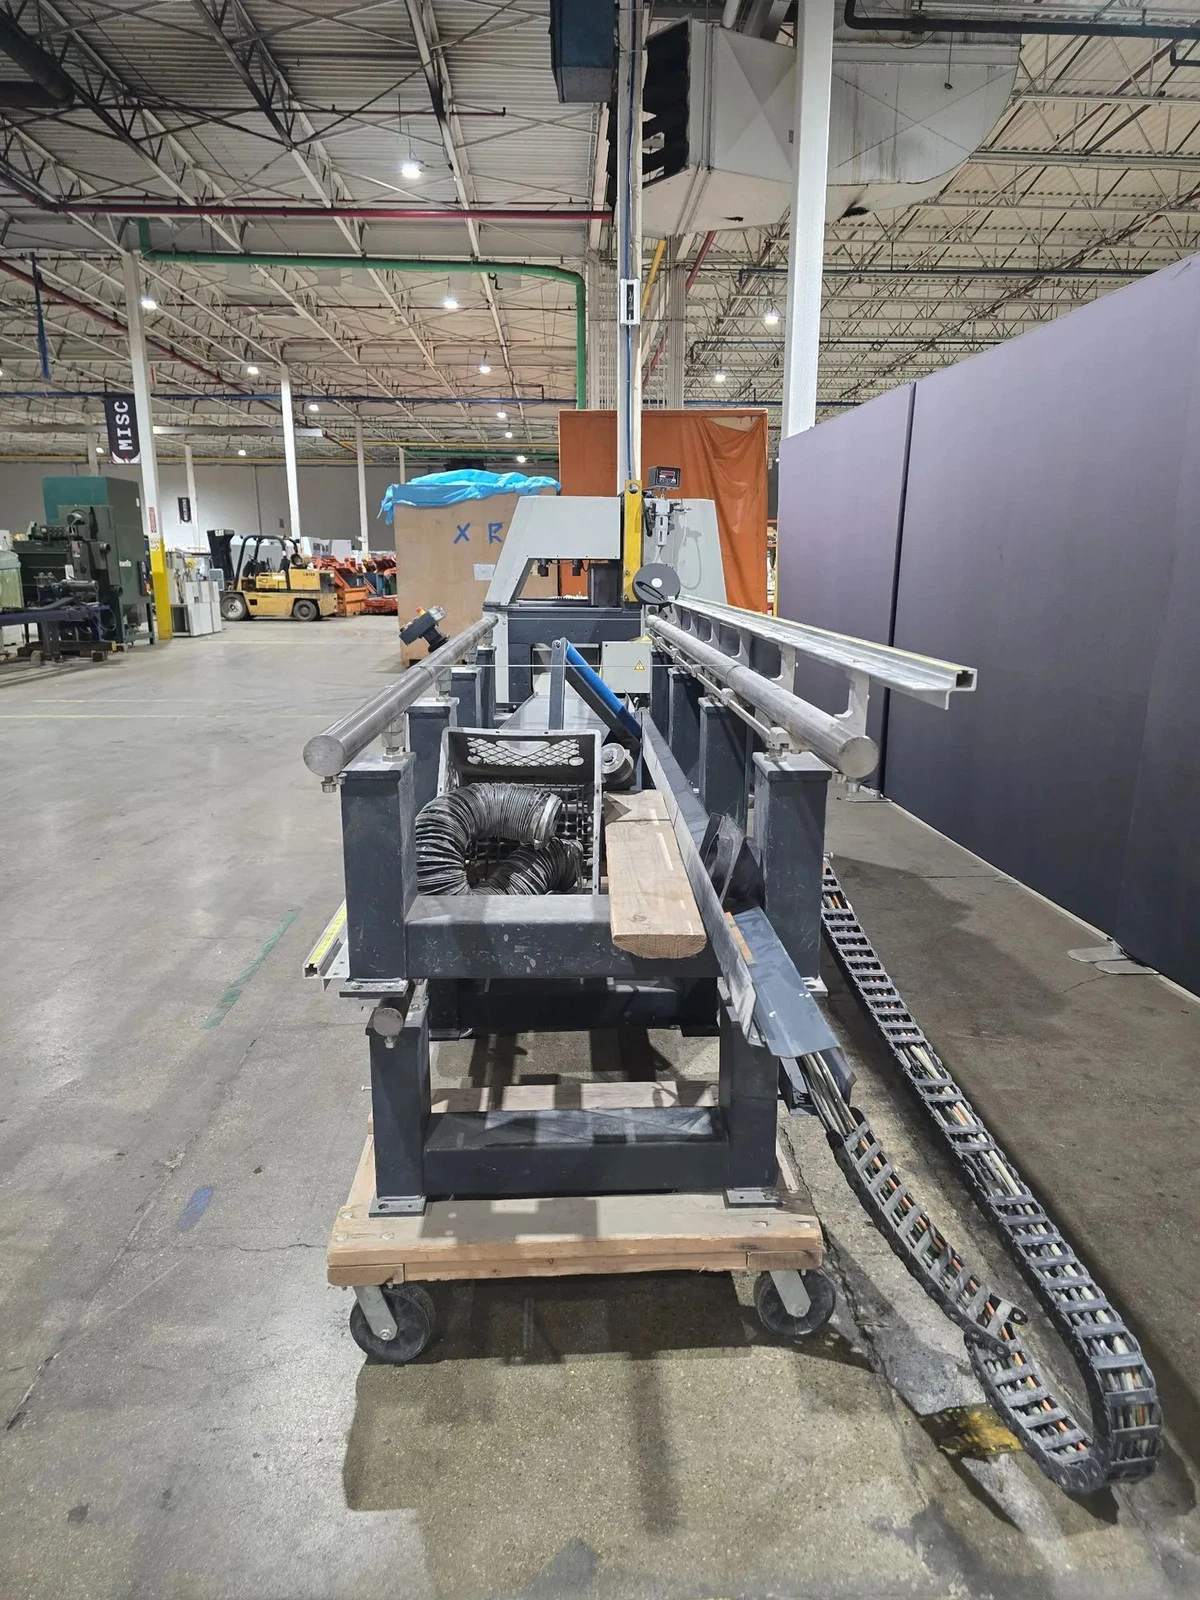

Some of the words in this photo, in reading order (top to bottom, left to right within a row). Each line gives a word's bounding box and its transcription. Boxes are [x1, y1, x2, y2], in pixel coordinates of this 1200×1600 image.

[114, 401, 133, 450] MISC
[453, 522, 471, 544] X
[488, 522, 504, 544] R
